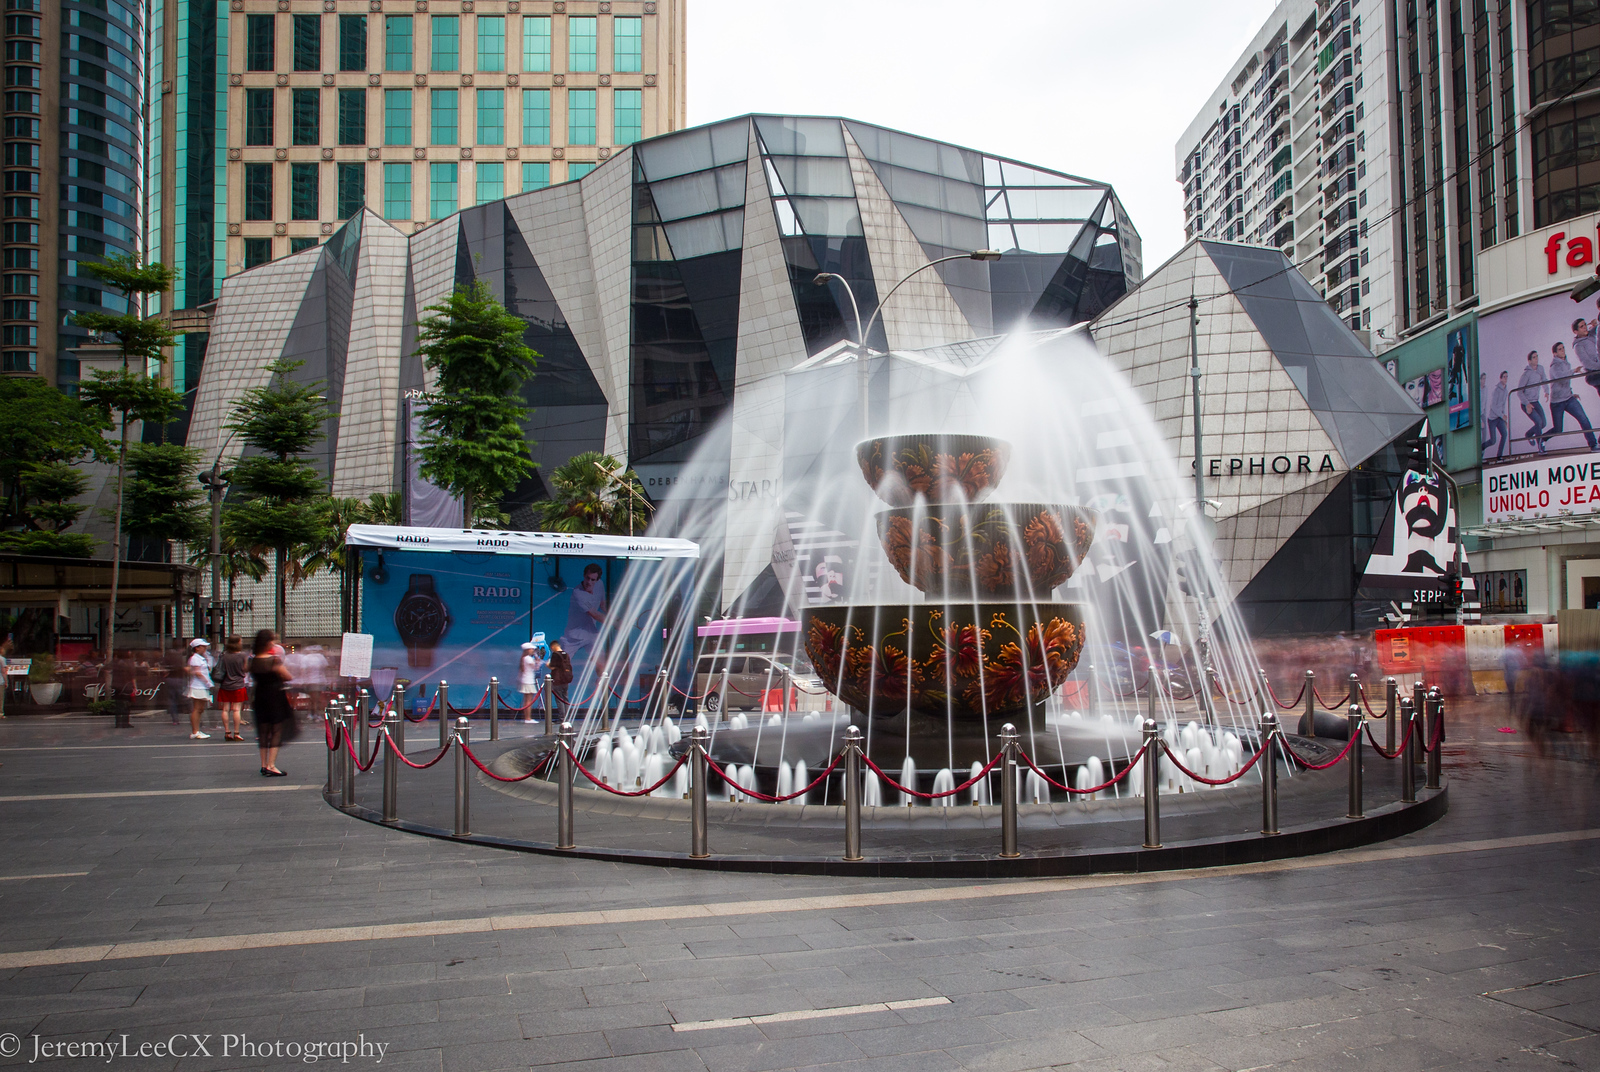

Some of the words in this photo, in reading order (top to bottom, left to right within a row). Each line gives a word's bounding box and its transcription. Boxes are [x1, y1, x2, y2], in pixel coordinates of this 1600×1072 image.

[1544, 231, 1600, 275] fa
[649, 475, 725, 486] DEBENHAMS
[1489, 469, 1538, 493] DENIM
[729, 478, 778, 500] STAR
[1489, 490, 1550, 513] UNIQLO
[1559, 485, 1600, 505] JEA
[396, 535, 430, 544] RADO
[477, 539, 509, 547] RADO
[473, 586, 521, 598] RADO
[1414, 589, 1465, 602] SEPH
